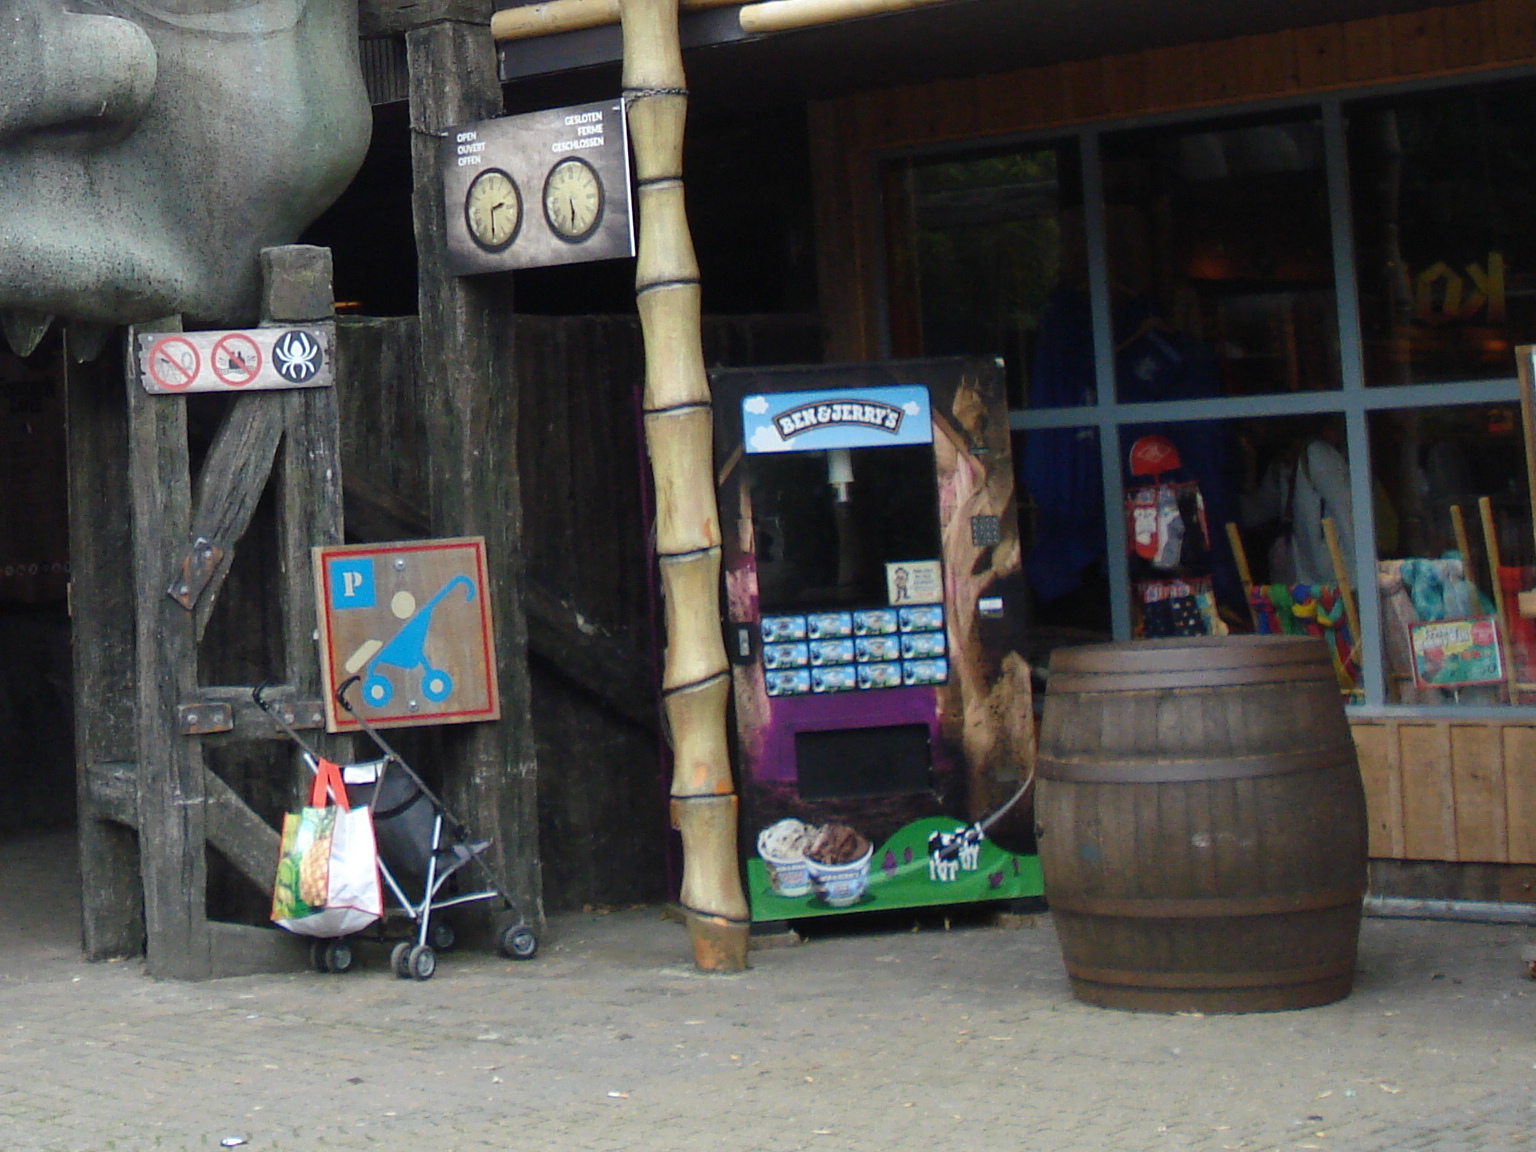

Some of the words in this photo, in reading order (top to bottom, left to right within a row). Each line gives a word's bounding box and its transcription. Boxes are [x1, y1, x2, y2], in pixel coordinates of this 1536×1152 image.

[564, 111, 603, 126] GESLOTEN
[456, 131, 477, 143] OPEN
[457, 141, 486, 155] OUVERT
[551, 136, 604, 153] GESCHLOSSEN
[457, 154, 481, 166] OFFEN
[342, 570, 362, 598] P
